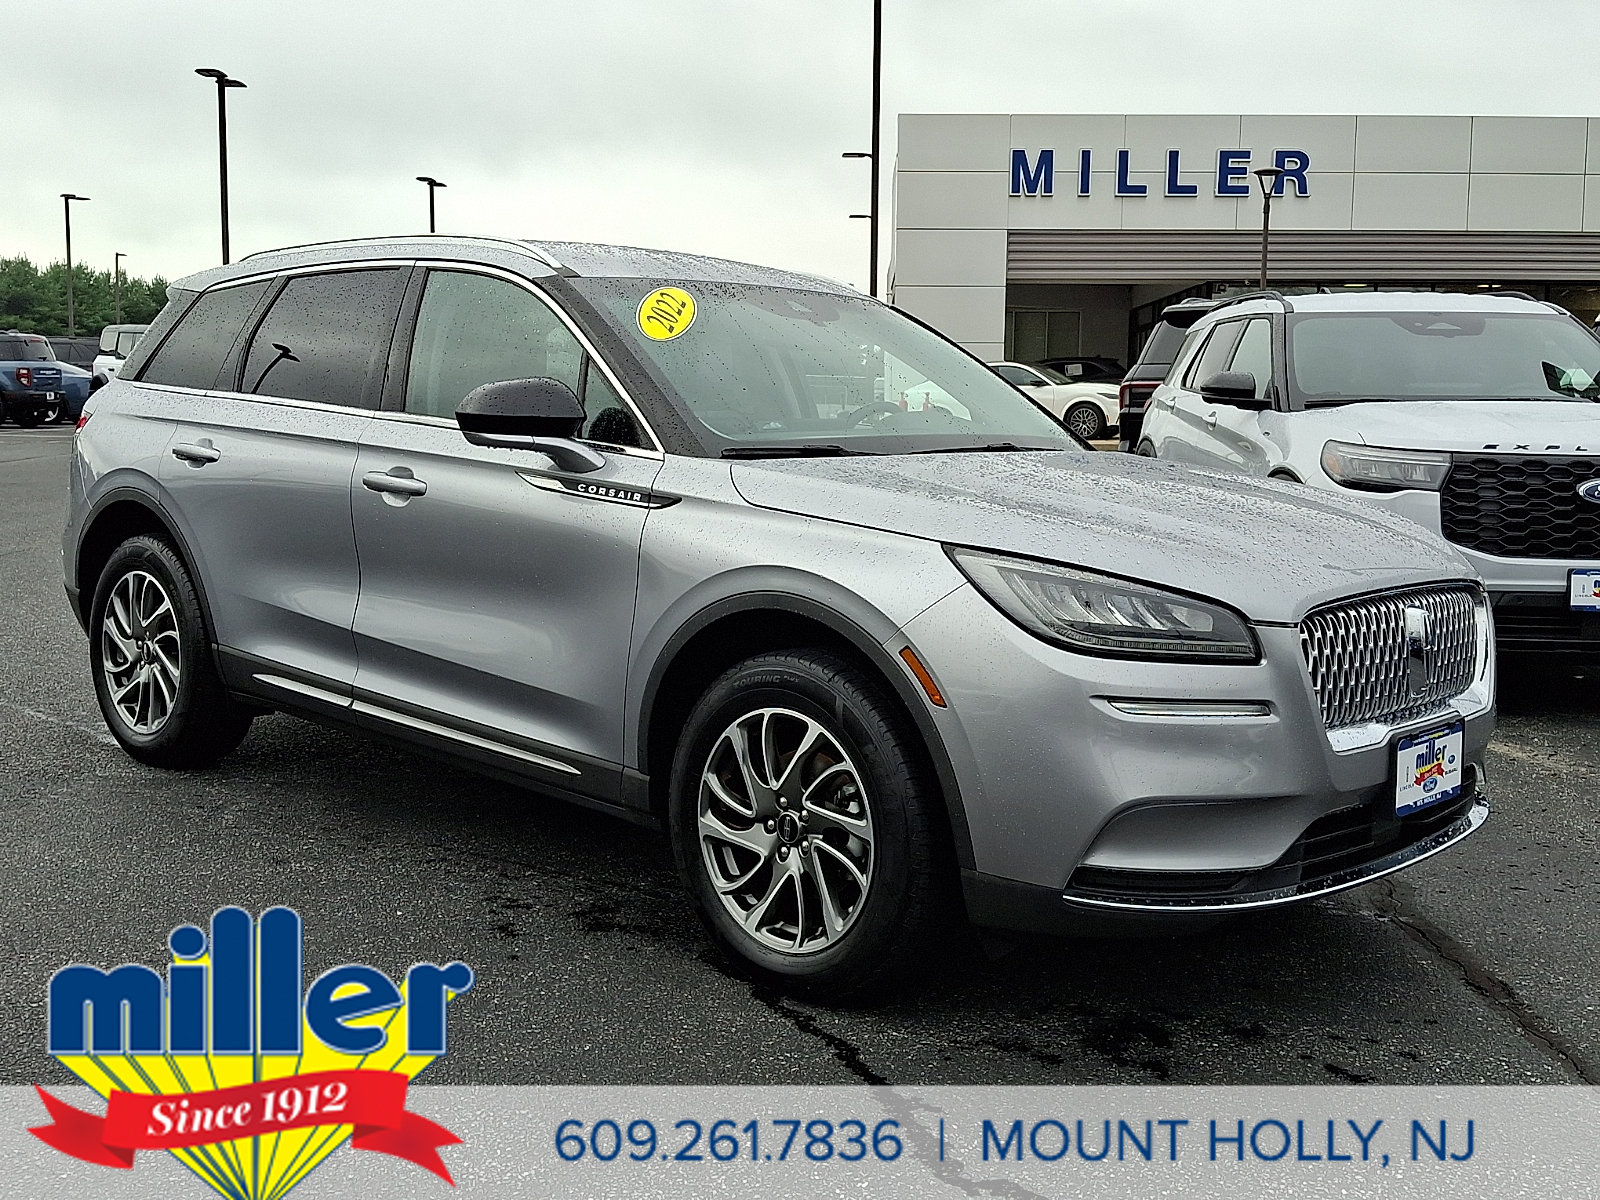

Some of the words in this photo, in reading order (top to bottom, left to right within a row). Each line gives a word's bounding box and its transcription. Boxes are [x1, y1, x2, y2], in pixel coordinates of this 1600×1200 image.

[1009, 148, 1311, 197] MILLER
[646, 292, 687, 334] 2022
[577, 483, 643, 502] CORSAIR
[733, 674, 781, 688] TOURING
[1415, 739, 1448, 769] miller
